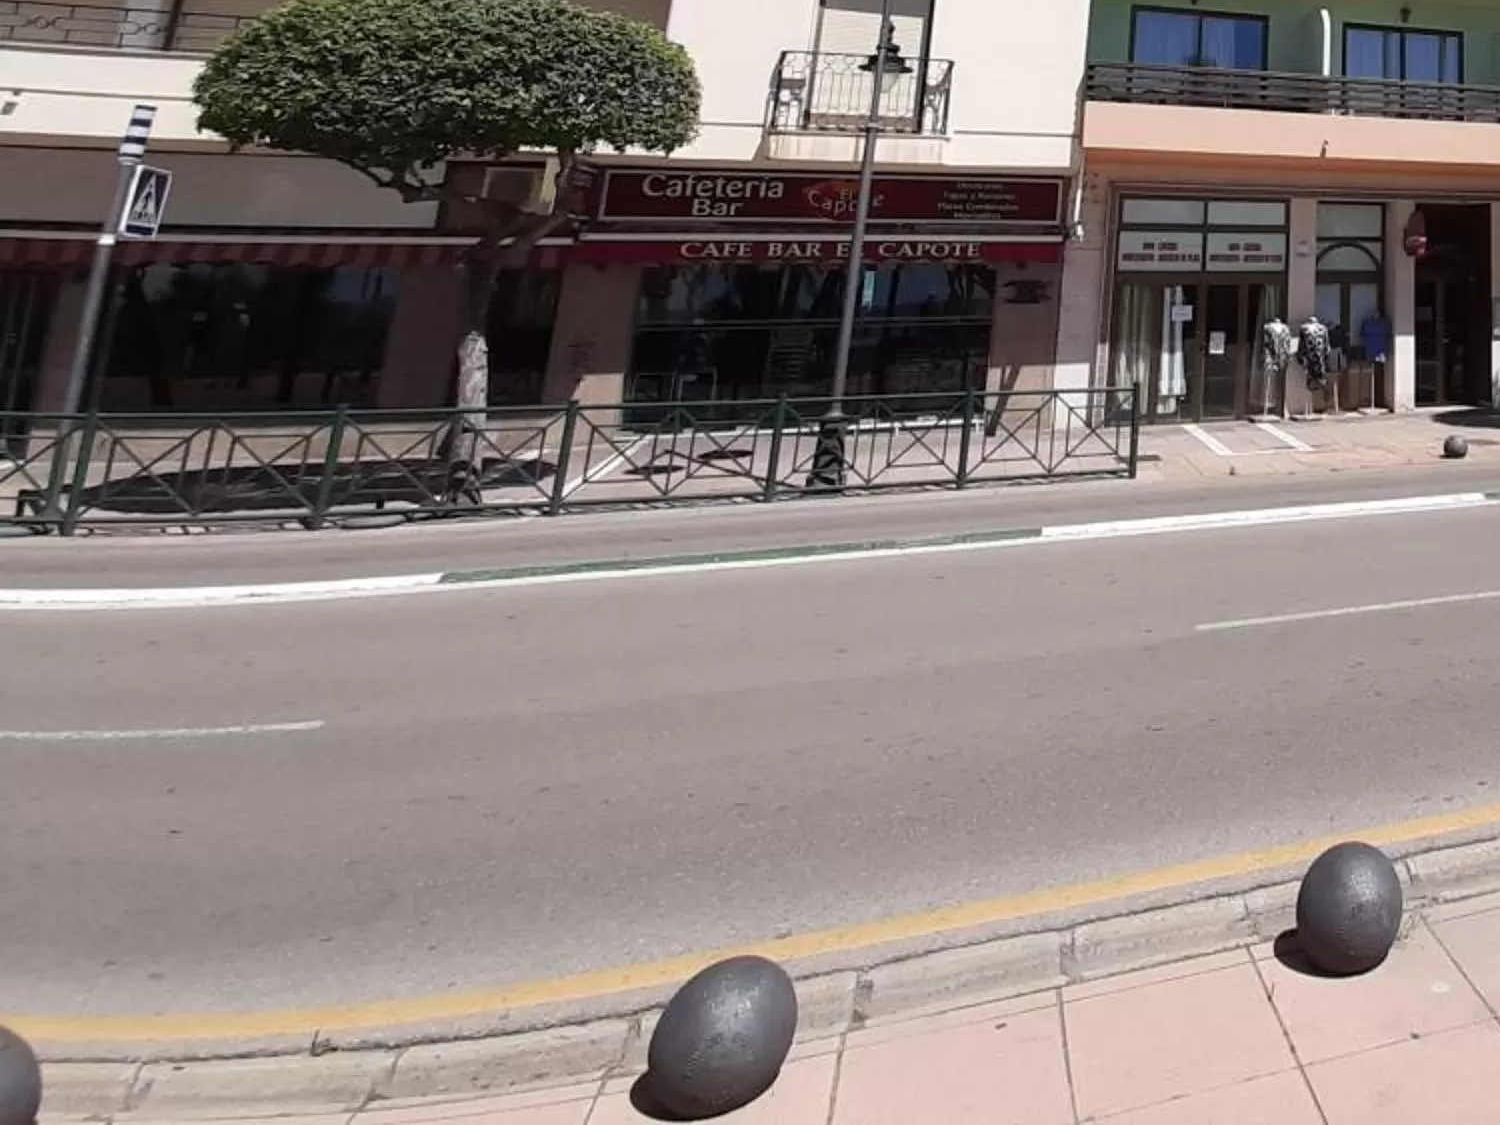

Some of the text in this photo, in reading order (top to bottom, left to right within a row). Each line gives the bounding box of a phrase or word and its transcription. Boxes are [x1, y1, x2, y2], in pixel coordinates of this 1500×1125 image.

[691, 199, 744, 216] Bar
[807, 190, 885, 216] Capoe
[680, 242, 981, 258] CAFE BAR E CAPOTE
